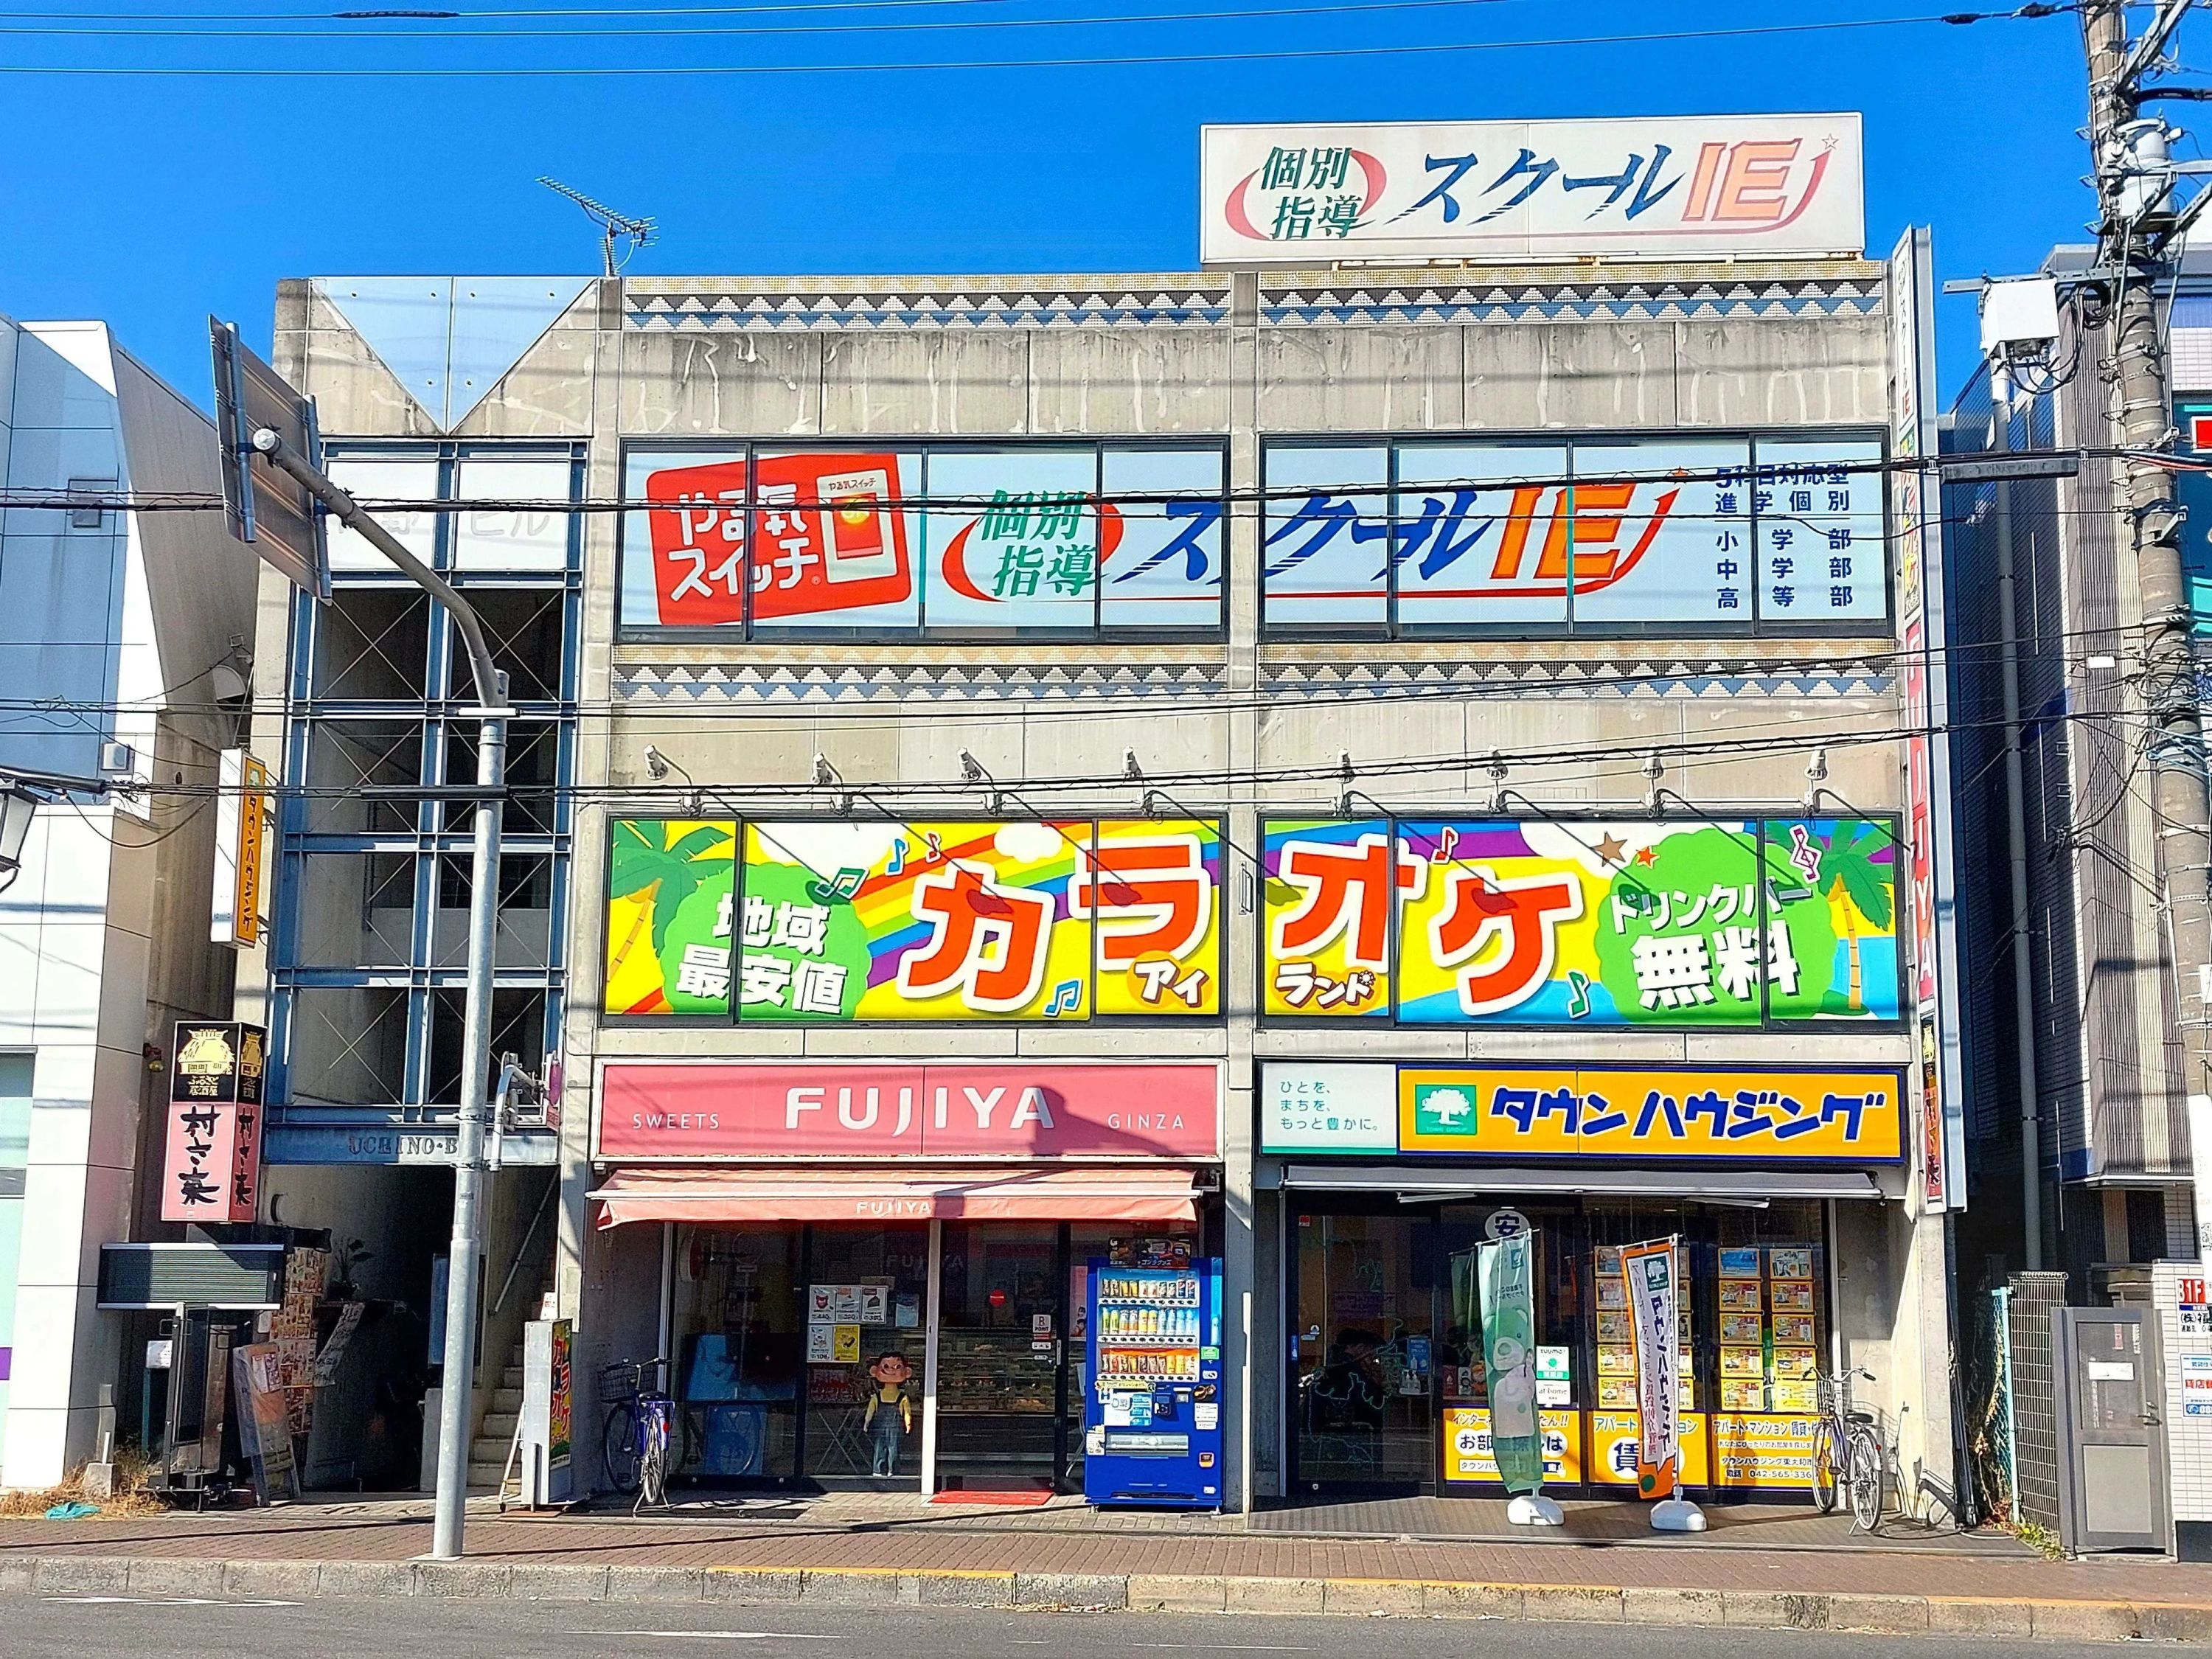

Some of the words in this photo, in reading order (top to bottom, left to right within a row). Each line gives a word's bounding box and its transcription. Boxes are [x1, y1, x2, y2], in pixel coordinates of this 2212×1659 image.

[1261, 145, 1352, 191] 個別
[1383, 137, 1804, 223] スクールIE
[1270, 194, 1364, 240] 指導
[669, 483, 809, 546] やる気
[980, 488, 1085, 541] 個別
[1715, 528, 1852, 552] 小学部
[668, 537, 820, 602] スイッチ
[992, 543, 1097, 599] 指導
[1717, 557, 1852, 581] 中学部
[1717, 585, 1854, 609] 高等部
[243, 796, 257, 933] タウンハウジング
[714, 891, 830, 955] 地域
[1610, 876, 1812, 935] ドリンクバー
[677, 942, 849, 1017] 最安値
[1635, 920, 1799, 1011] 無料
[785, 1086, 1056, 1137] FUJIYA
[1280, 1081, 1330, 1094] ひとを、
[1280, 1099, 1331, 1112] まちを、
[632, 1111, 720, 1130] SWEETS
[1107, 1112, 1186, 1130] GINZA
[1280, 1117, 1378, 1131] もっと豊かに。
[1489, 1087, 1886, 1141] タウンハウジング
[178, 1105, 221, 1206] 村さ来
[856, 1200, 932, 1215] FUJIYA
[1750, 1470, 1812, 1478] 042-565-336
